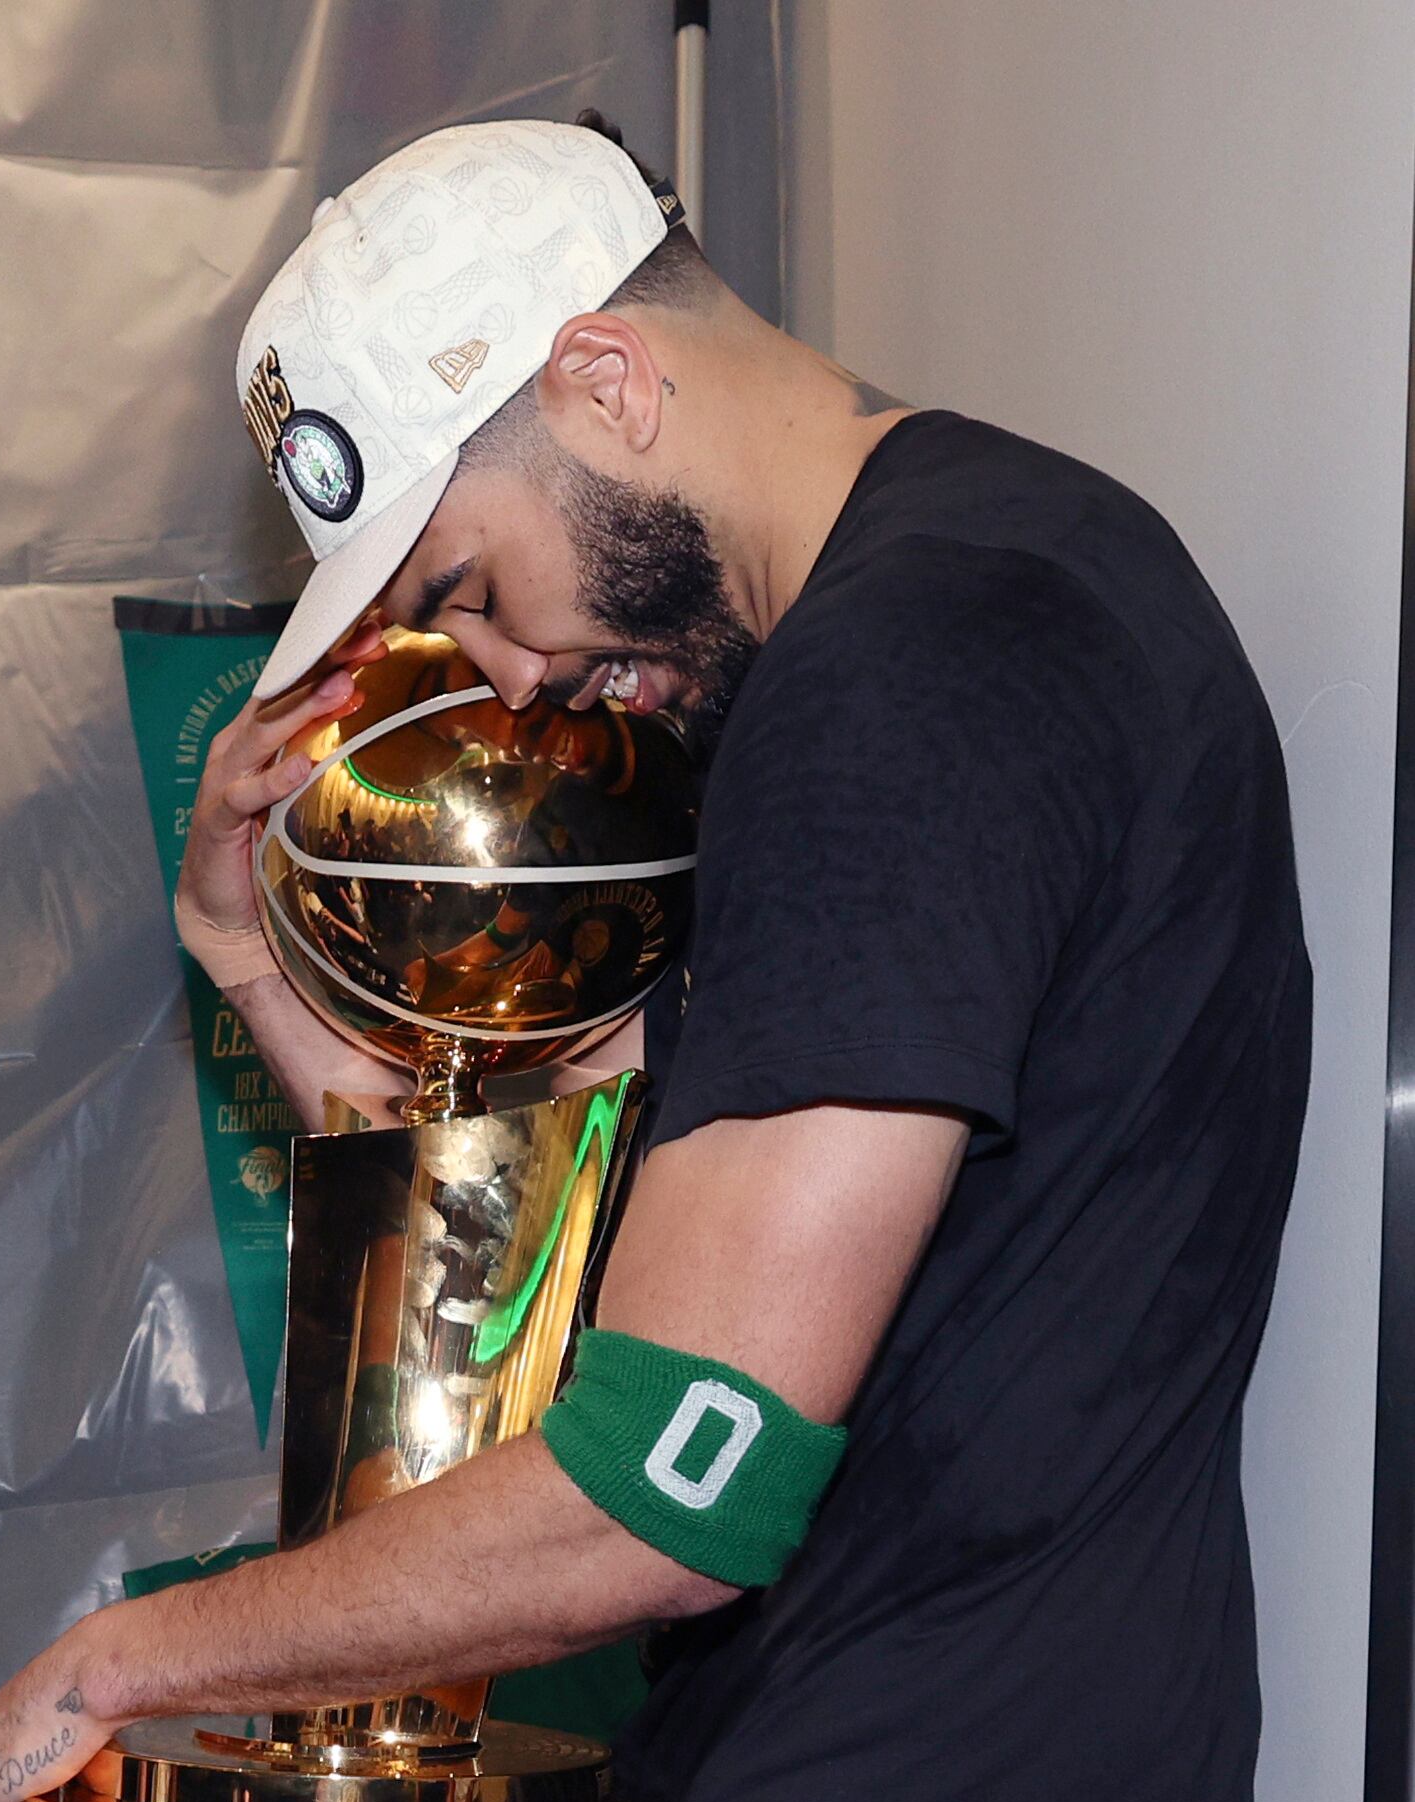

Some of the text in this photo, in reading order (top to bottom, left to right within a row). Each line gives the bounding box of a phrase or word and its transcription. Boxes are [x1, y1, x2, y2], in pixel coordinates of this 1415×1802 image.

[176, 688, 223, 765] NATIONAL
[645, 1379, 763, 1510] 0
[0, 1727, 77, 1796] Deuce
